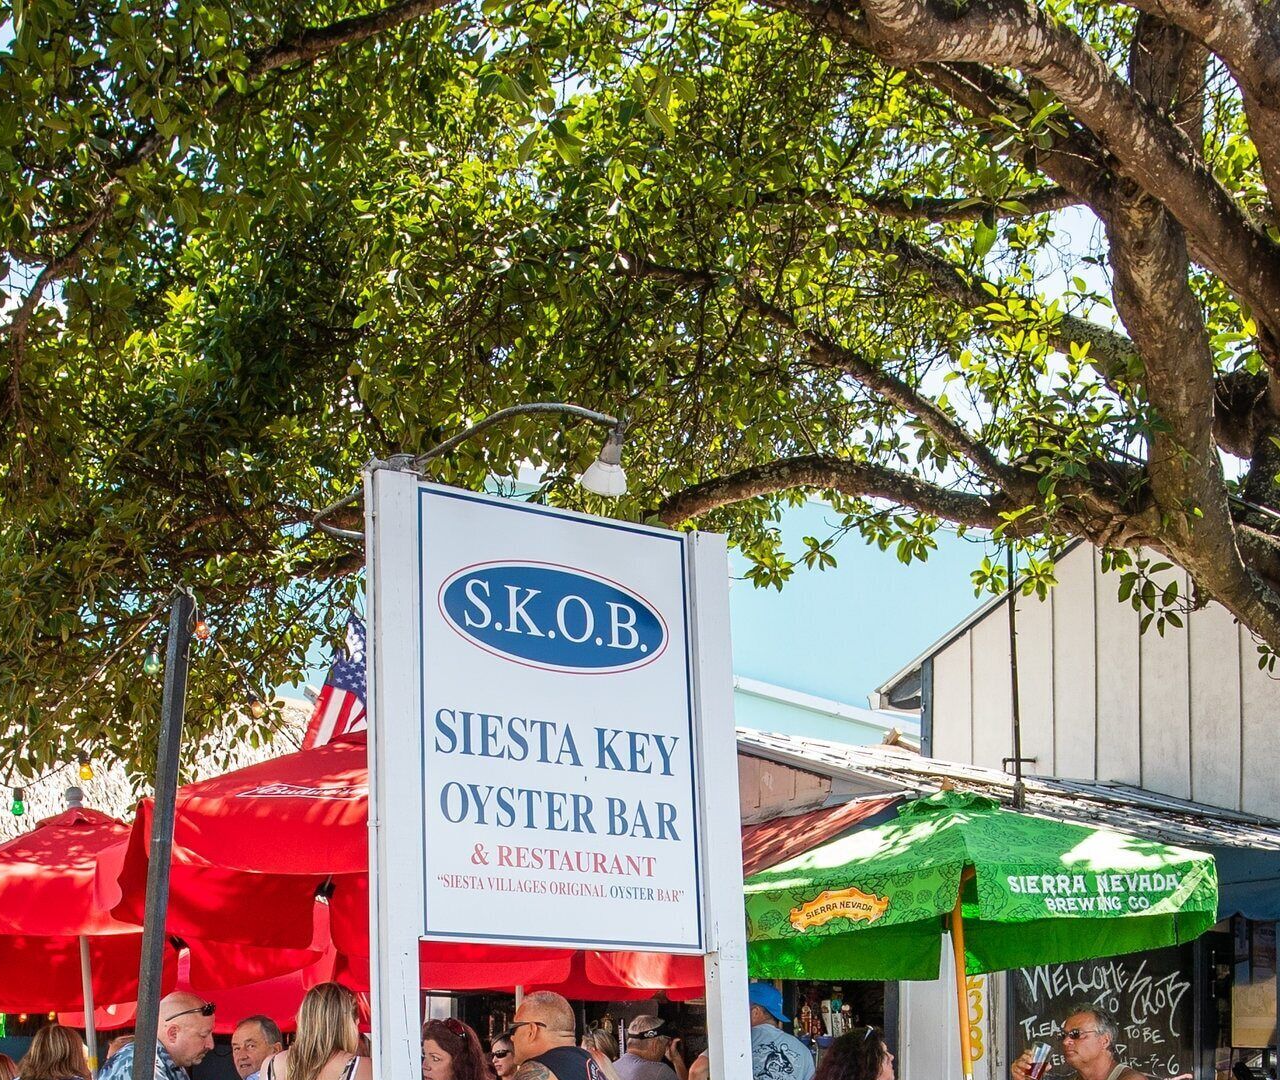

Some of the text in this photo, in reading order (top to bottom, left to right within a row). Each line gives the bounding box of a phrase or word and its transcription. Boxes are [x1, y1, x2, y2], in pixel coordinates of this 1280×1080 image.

[463, 578, 648, 652] S.K.O.B.
[434, 708, 680, 777] SIESTA KEY
[440, 780, 682, 841] OYSTER BAR
[470, 843, 657, 878] & RESTAURANT
[488, 877, 547, 895] VILLAGES
[549, 880, 608, 898] ORIGINAL
[609, 884, 655, 901] OYSTER
[1006, 872, 1180, 896] SIERRA NEVADA
[805, 901, 873, 920] SIERRA NEVADA
[1045, 896, 1122, 912] BREWING
[1020, 960, 1129, 1002] WELCOME
[1092, 989, 1119, 1013] TO
[1124, 1025, 1139, 1039] TO
[1143, 1027, 1165, 1044] BE
